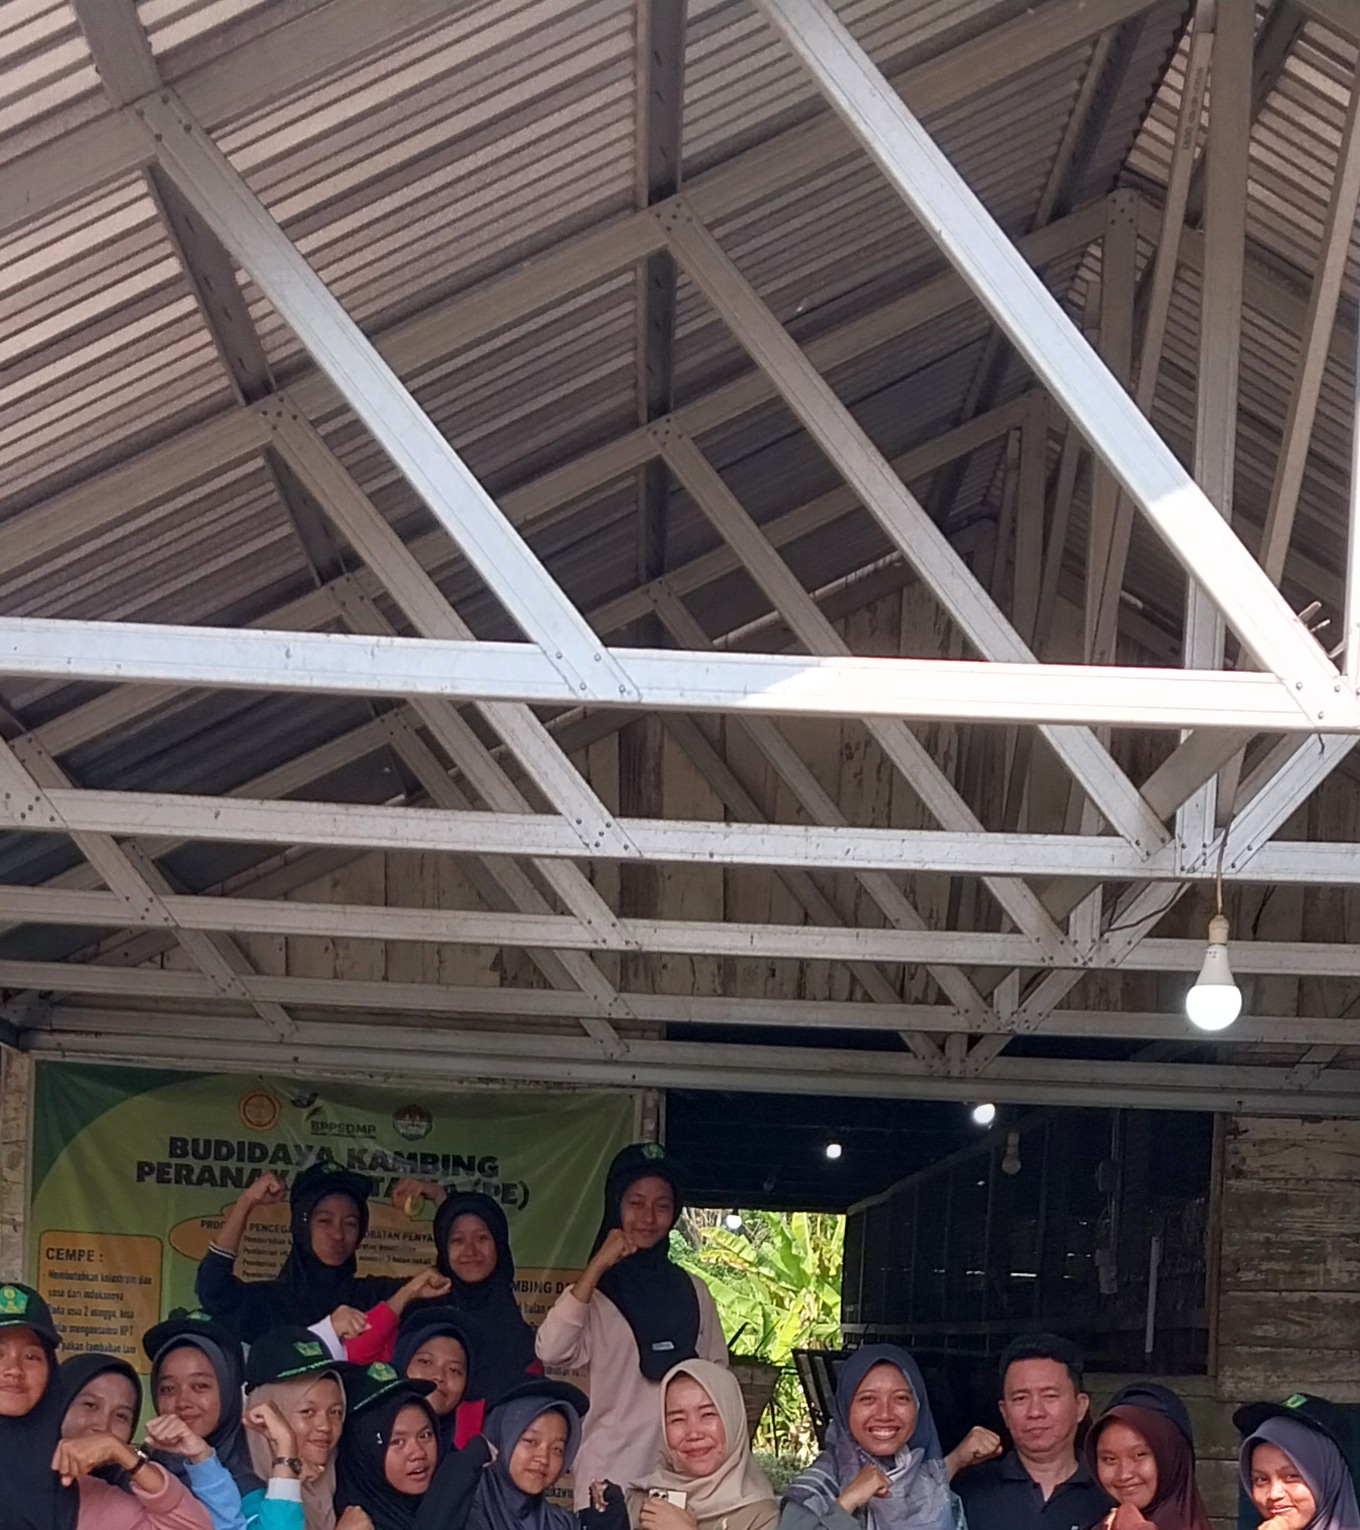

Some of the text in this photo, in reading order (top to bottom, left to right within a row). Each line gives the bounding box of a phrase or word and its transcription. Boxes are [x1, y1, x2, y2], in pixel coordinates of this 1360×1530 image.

[168, 1136, 499, 1178] BUDIDAYA KAMBING
[46, 1247, 95, 1262] CEMPE
